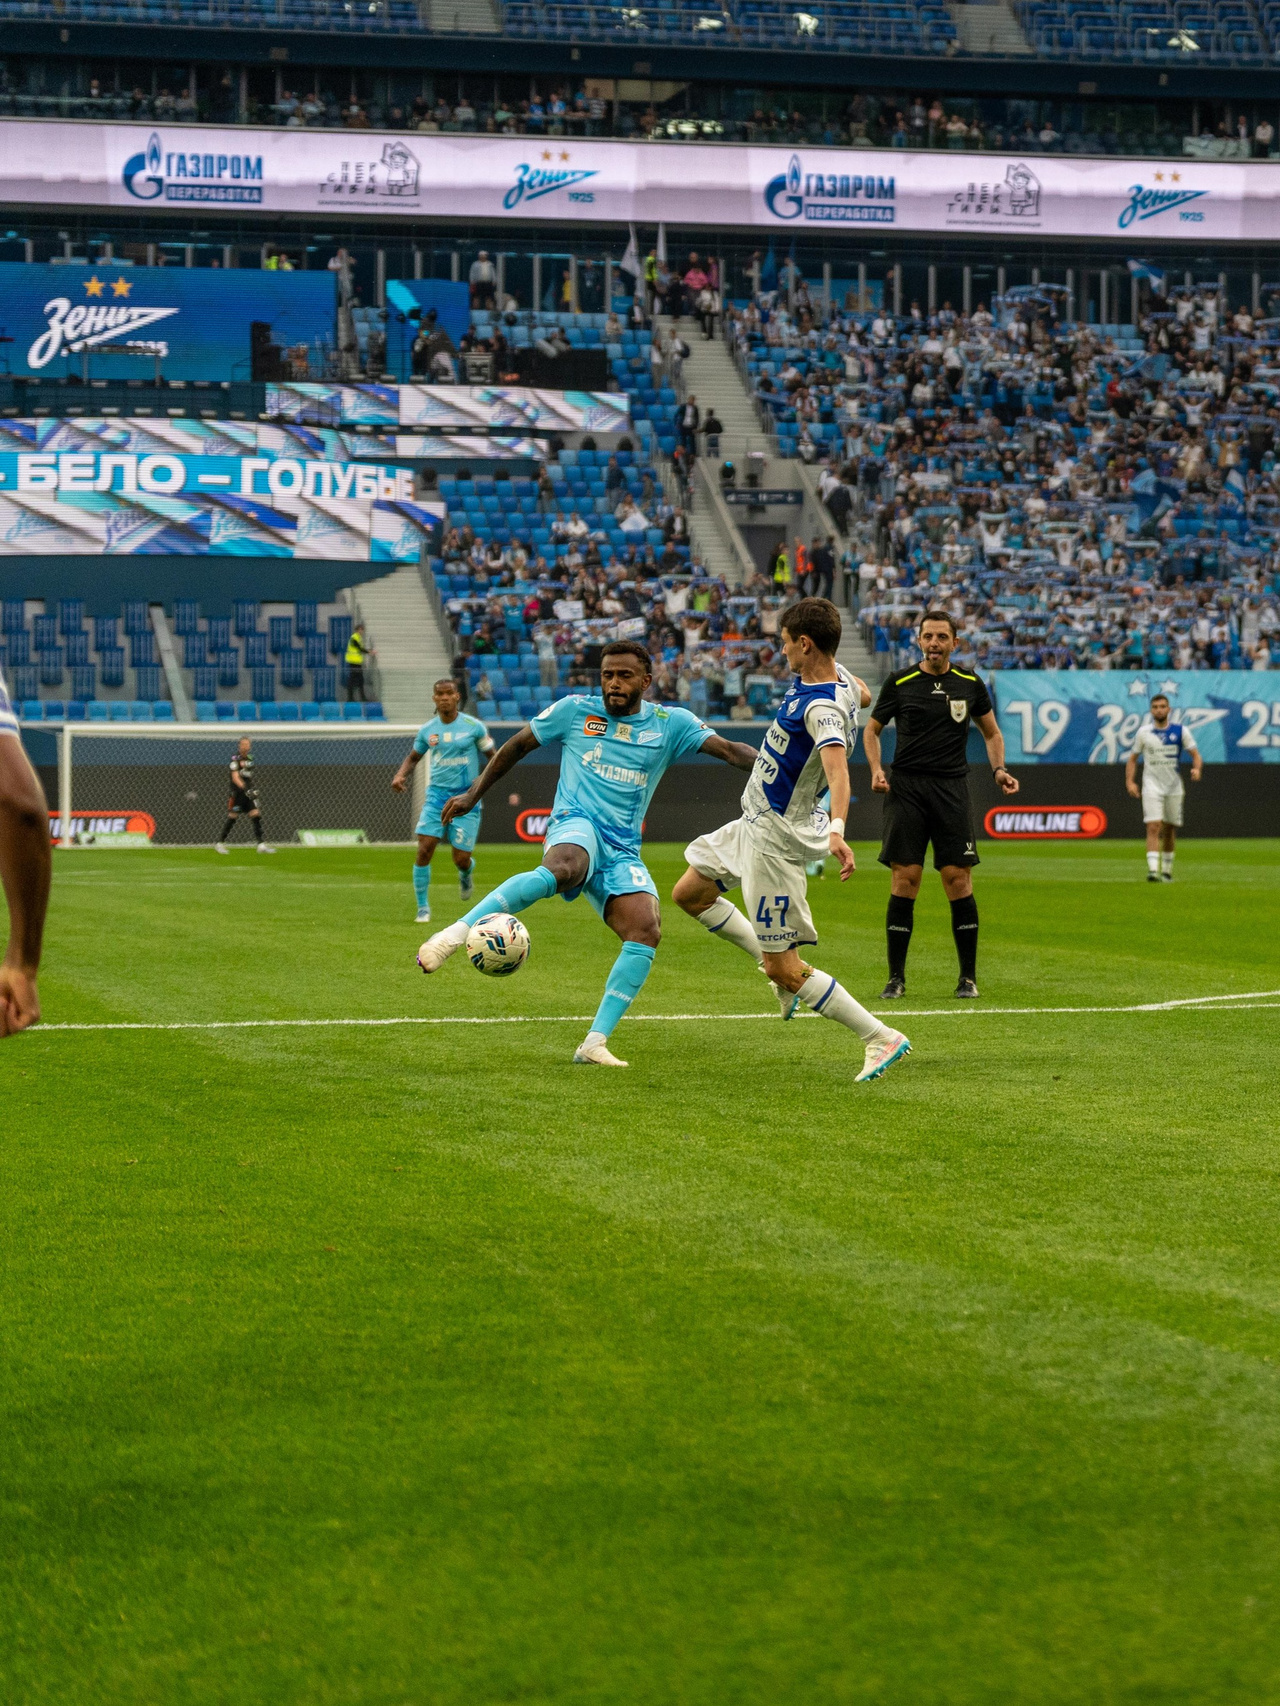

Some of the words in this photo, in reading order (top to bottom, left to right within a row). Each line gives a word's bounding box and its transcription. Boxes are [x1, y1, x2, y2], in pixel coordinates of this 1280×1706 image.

[165, 152, 263, 180] ГАЗПРОМ
[167, 185, 262, 202] ПЕРЕРАБОТКА
[804, 173, 896, 200] ГАЗПРОМ
[568, 192, 595, 203] 1925
[806, 204, 894, 221] ПЕРЕРАБОТКА
[1179, 211, 1205, 222] 1925
[28, 297, 180, 369] Зенит
[16, 455, 187, 493] БЕЛО
[240, 458, 415, 502] ГОЛУБЫЕ
[589, 722, 606, 732] WIN
[1005, 700, 1071, 755] 19
[994, 812, 1081, 833] WINLINE
[629, 866, 647, 887] 8
[756, 895, 790, 928] 47
